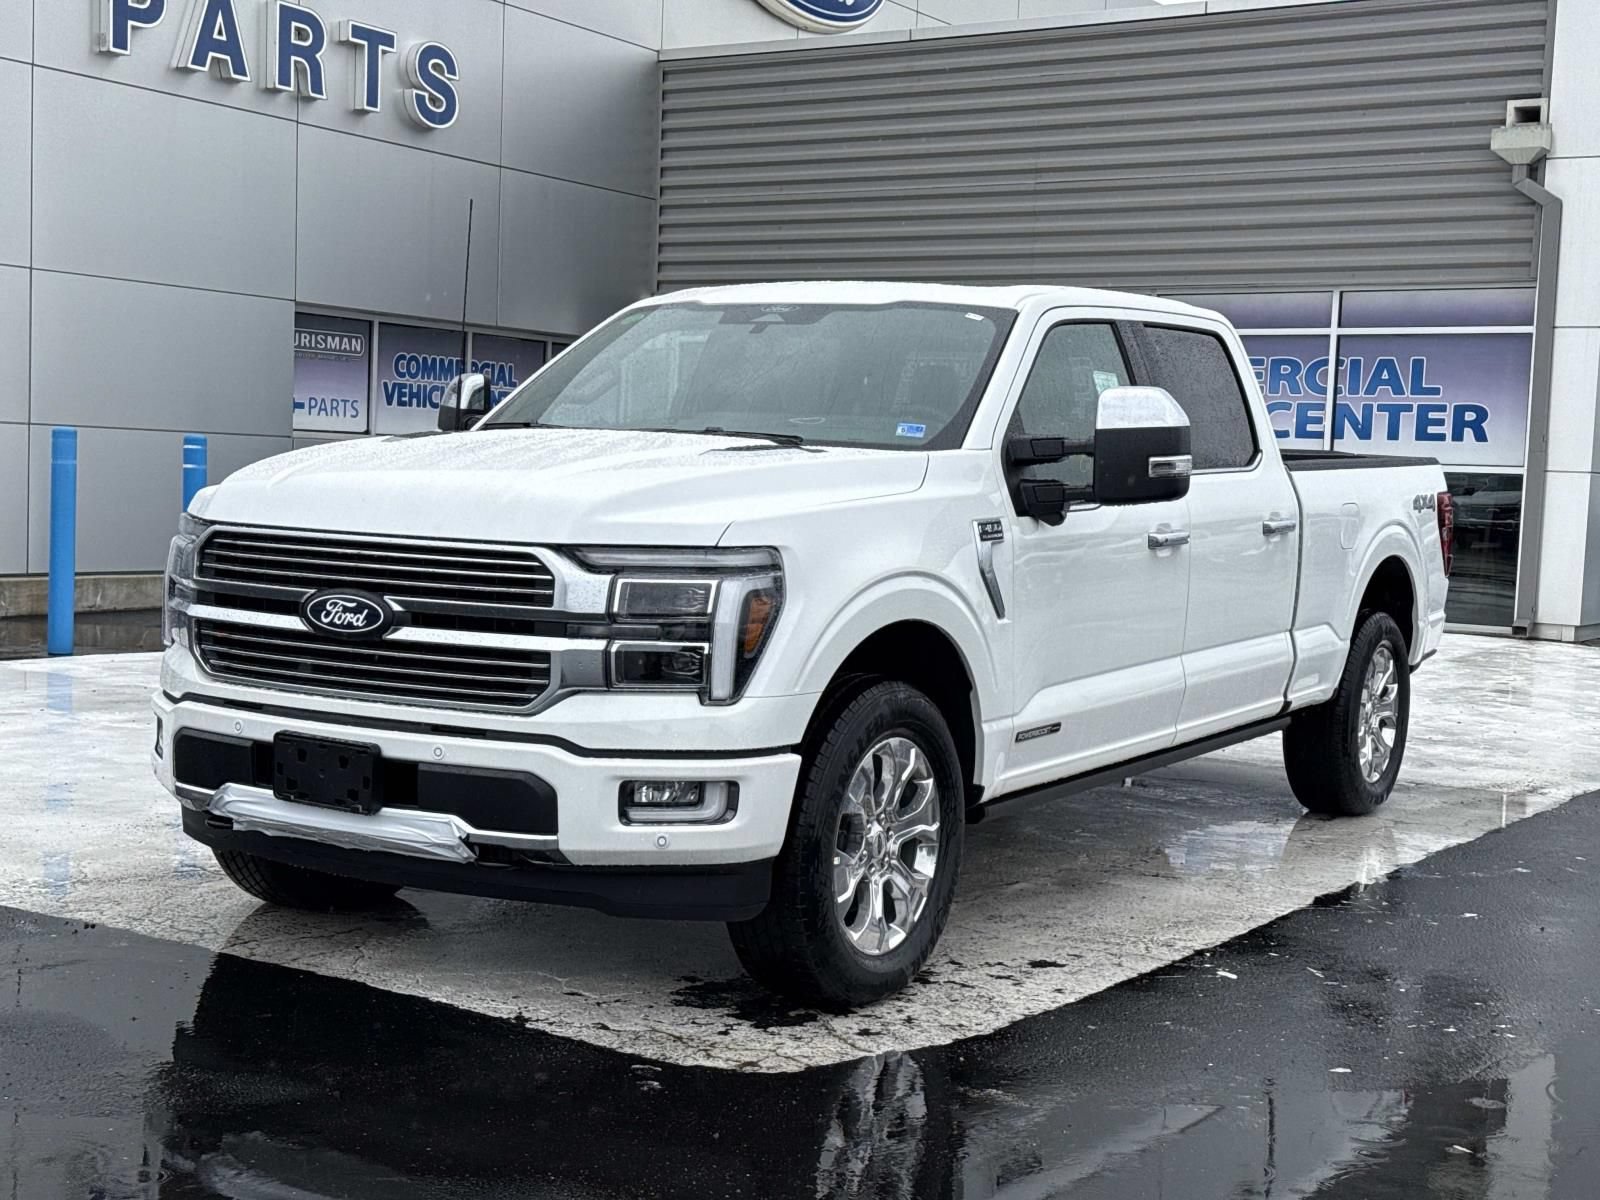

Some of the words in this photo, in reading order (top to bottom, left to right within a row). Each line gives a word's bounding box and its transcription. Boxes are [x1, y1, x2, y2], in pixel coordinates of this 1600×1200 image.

[107, 0, 460, 129] PARTS
[393, 353, 518, 388] COMMCIAL
[308, 397, 359, 418] PARTS
[321, 599, 369, 627] Ford
